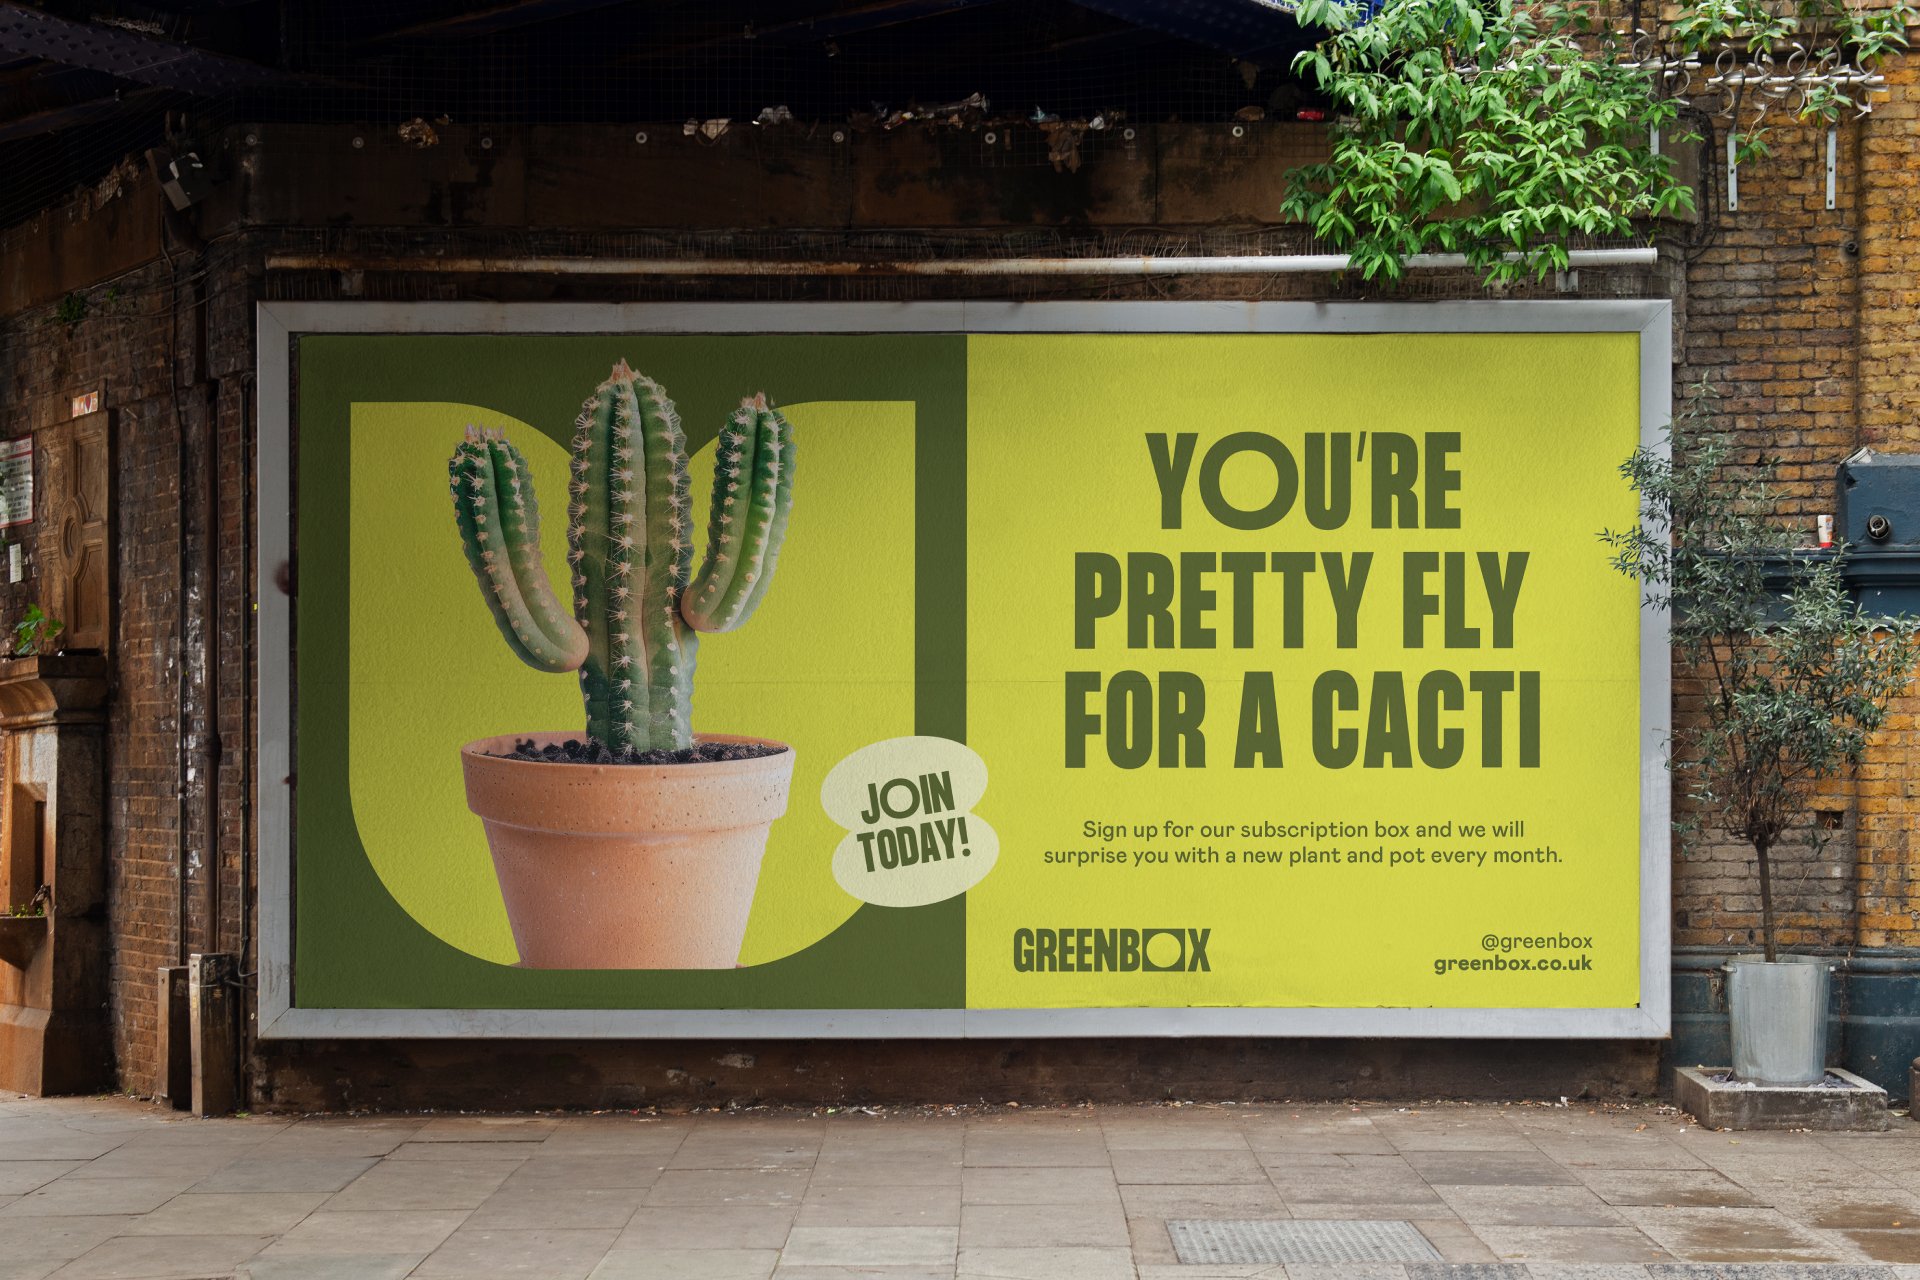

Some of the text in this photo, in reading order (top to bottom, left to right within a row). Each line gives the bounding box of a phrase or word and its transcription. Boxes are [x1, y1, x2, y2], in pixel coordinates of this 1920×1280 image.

[1144, 430, 1462, 531] YOU'RE
[1074, 551, 1531, 650] PRETTY FLY
[1064, 669, 1541, 770] FOR A CACTI
[860, 770, 956, 825] JOIN
[856, 816, 972, 874] TODAY!
[1082, 820, 1524, 842] Sign up for our subscription box and we will
[1044, 845, 1563, 868] surprise you with a new plant and pot every month.
[1013, 927, 1212, 973] GREENBOX
[1433, 954, 1593, 976] greenbox.co.uk
[1481, 931, 1593, 953] @greenbox
